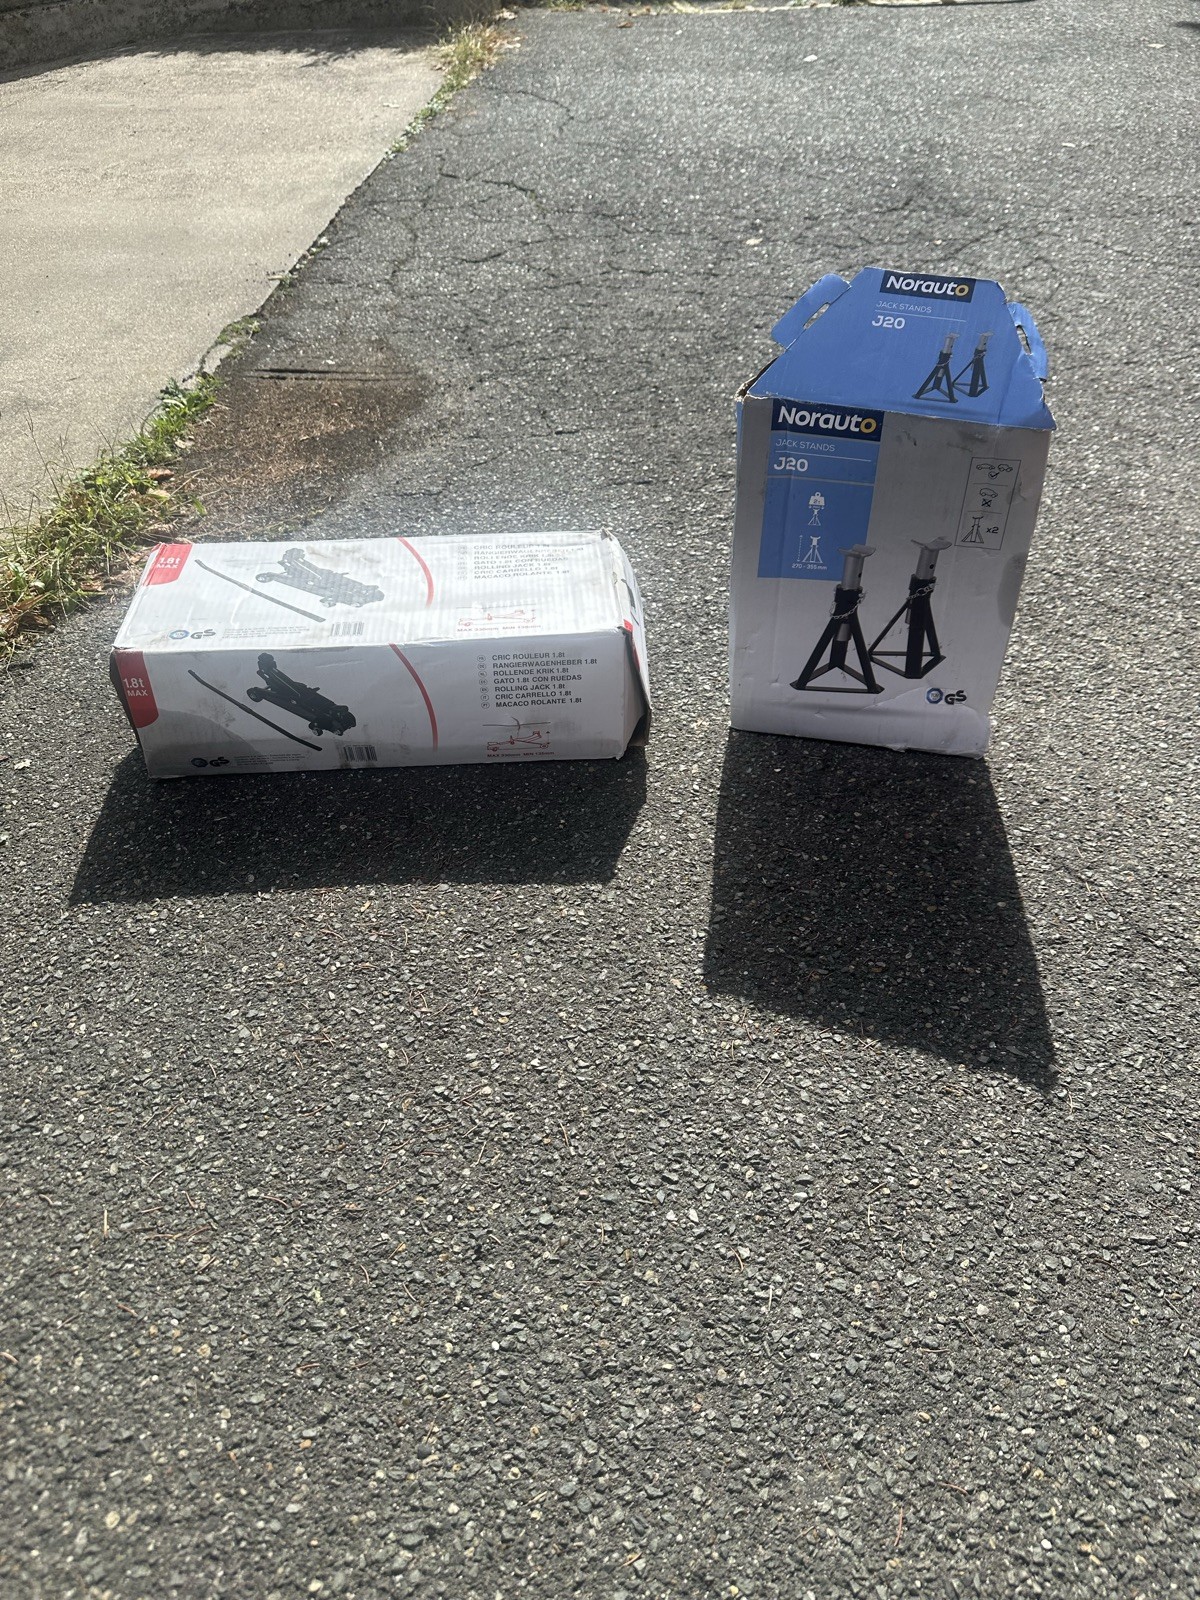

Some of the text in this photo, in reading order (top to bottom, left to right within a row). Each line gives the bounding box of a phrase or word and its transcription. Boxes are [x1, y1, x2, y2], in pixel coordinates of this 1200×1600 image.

[886, 275, 969, 297] Norauto
[876, 301, 932, 313] JACK STANDS
[871, 315, 906, 329] J20
[778, 405, 877, 434] Norauto
[776, 438, 836, 452] JACK STANDS
[774, 457, 808, 472] J20
[986, 526, 999, 534] x2
[159, 557, 181, 565] 1.8t
[190, 628, 216, 640] GS
[492, 659, 583, 669] RANGIERWAGENHEBER
[493, 668, 535, 676] ROLLENDE
[122, 677, 145, 689] 1.8t
[495, 684, 529, 692] ROLLING
[530, 683, 551, 691] JACK
[126, 689, 149, 697] MAX
[515, 691, 557, 699] CARRELLO
[944, 690, 967, 705] GS
[496, 700, 530, 708] MACACO
[530, 698, 567, 706] ROLANTE
[209, 756, 230, 768] GS
